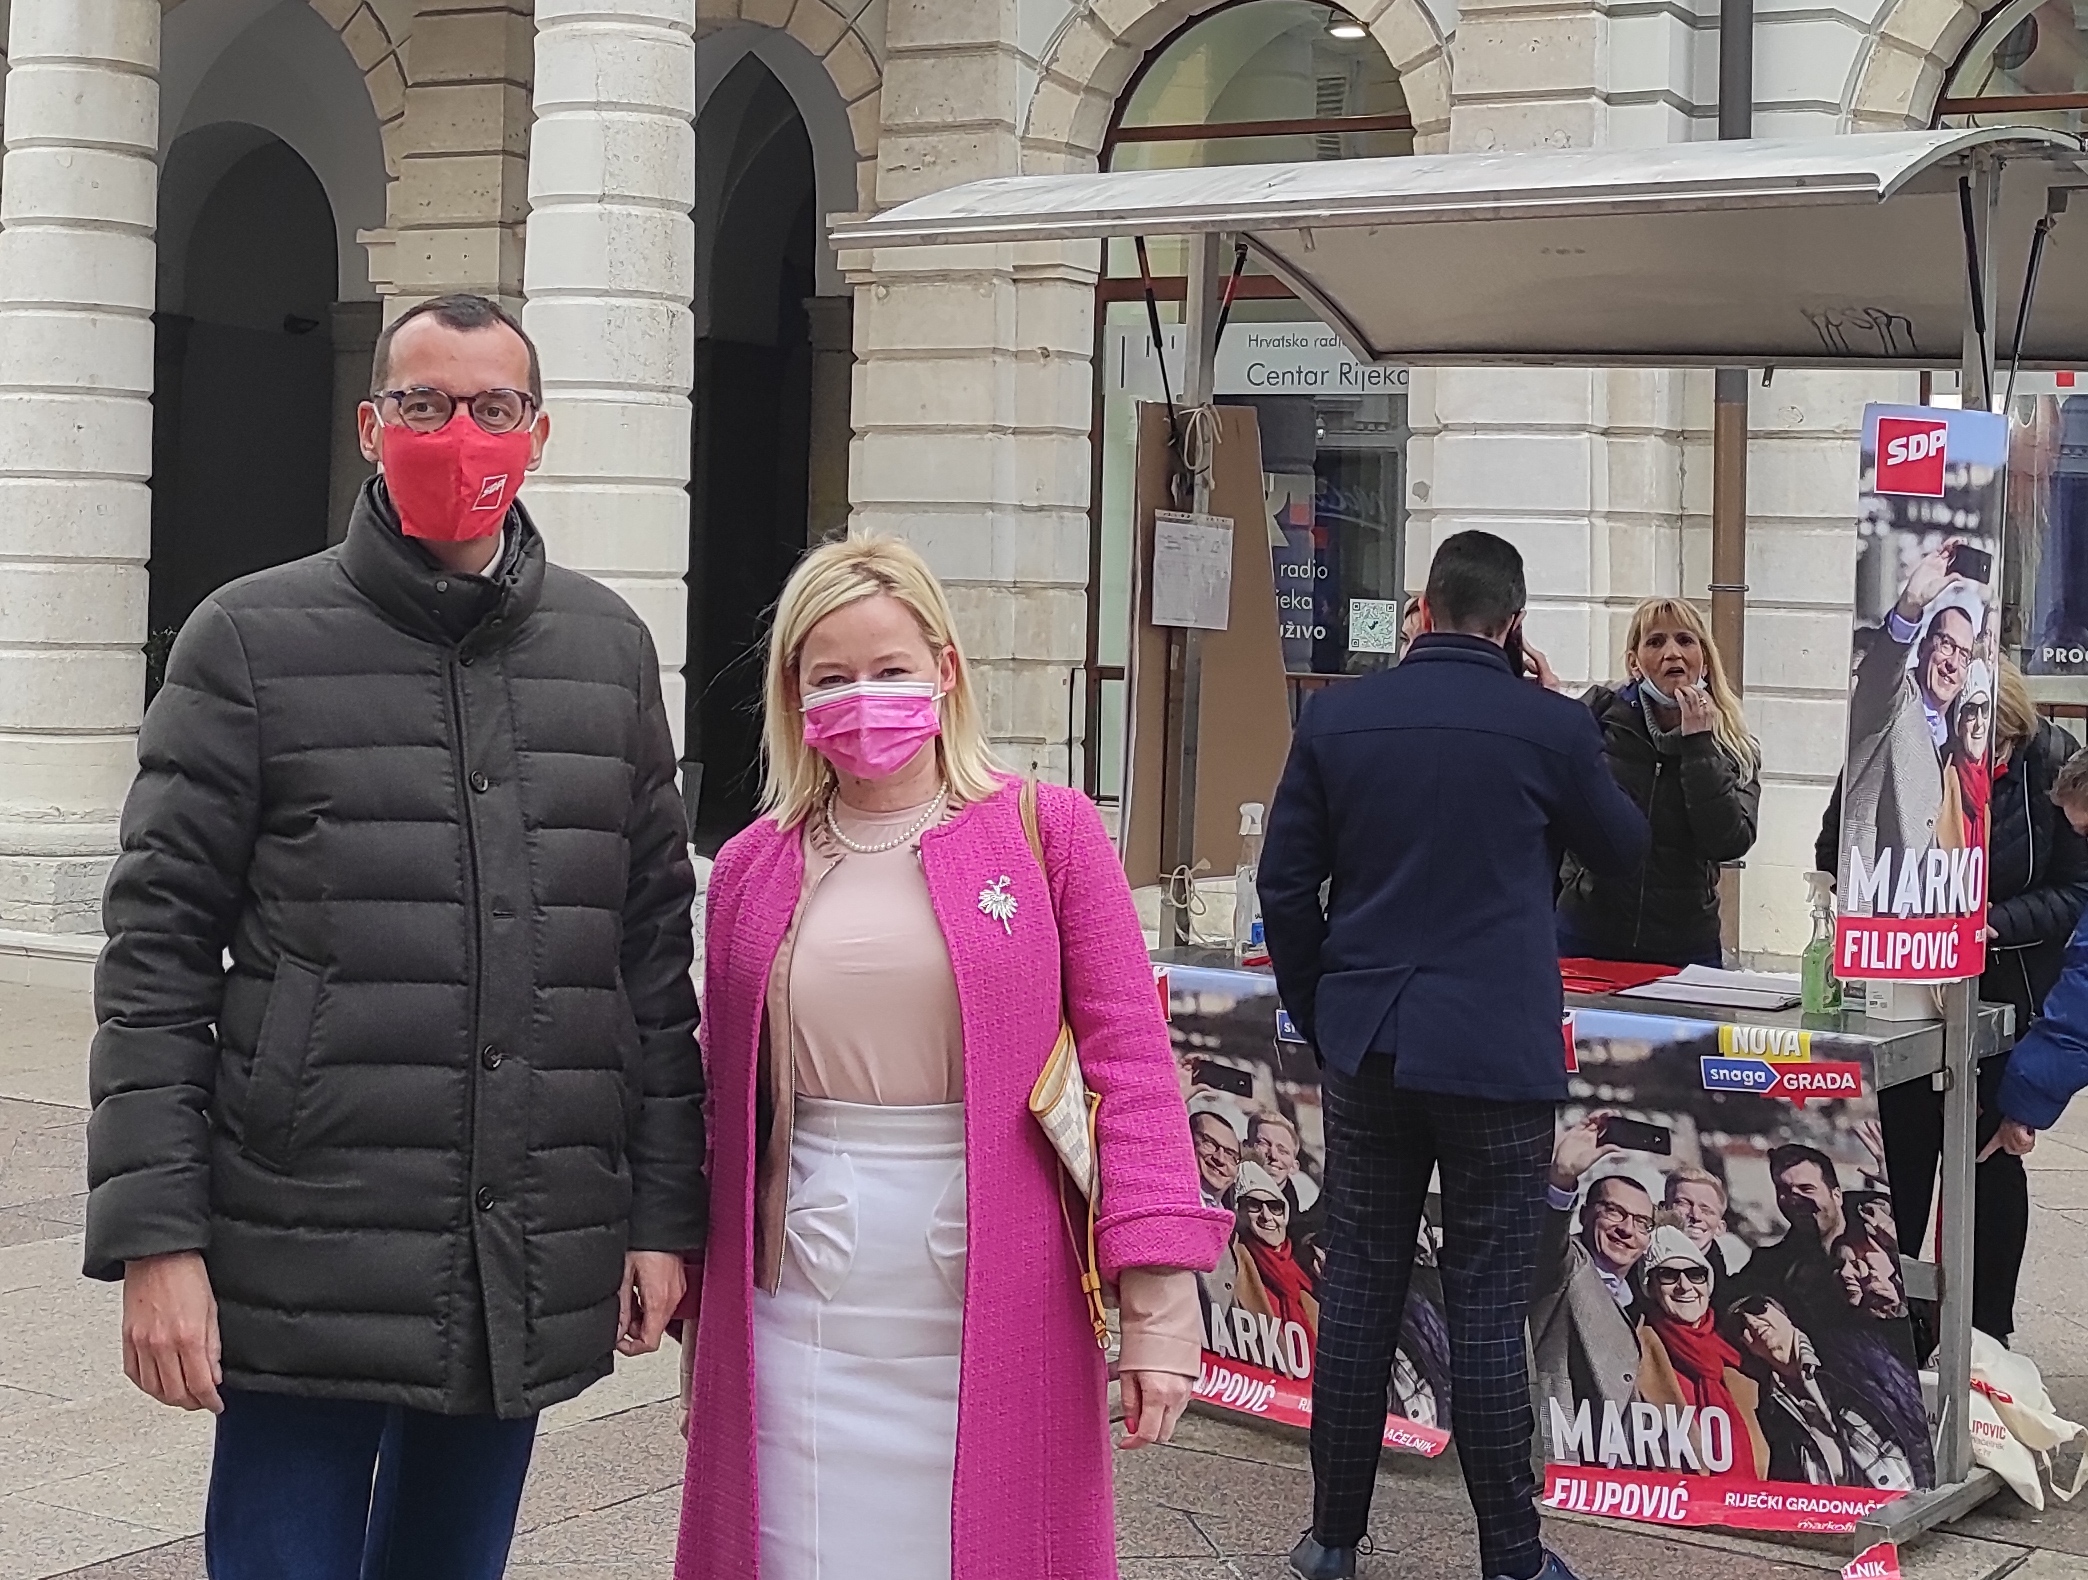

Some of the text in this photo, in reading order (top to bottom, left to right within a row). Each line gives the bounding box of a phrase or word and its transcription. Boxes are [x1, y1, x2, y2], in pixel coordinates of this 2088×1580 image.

[1248, 333, 1309, 348] Hrvatska
[1247, 362, 1329, 387] Centar
[1886, 428, 1947, 466] SDP
[1280, 558, 1328, 580] radio
[2043, 647, 2088, 664] PRO
[1847, 845, 1984, 915] MARKO
[1843, 922, 1959, 970] FILIPOVIĆ
[1732, 1026, 1802, 1057] NOVA
[1710, 1068, 1857, 1091] snaga GRADA
[1193, 1361, 1277, 1412] LIPOVIĆ
[1549, 1396, 1733, 1473] MARKO
[1554, 1477, 1689, 1520] FILIPOVIĆ
[1724, 1491, 1784, 1511] RIJEČKI
